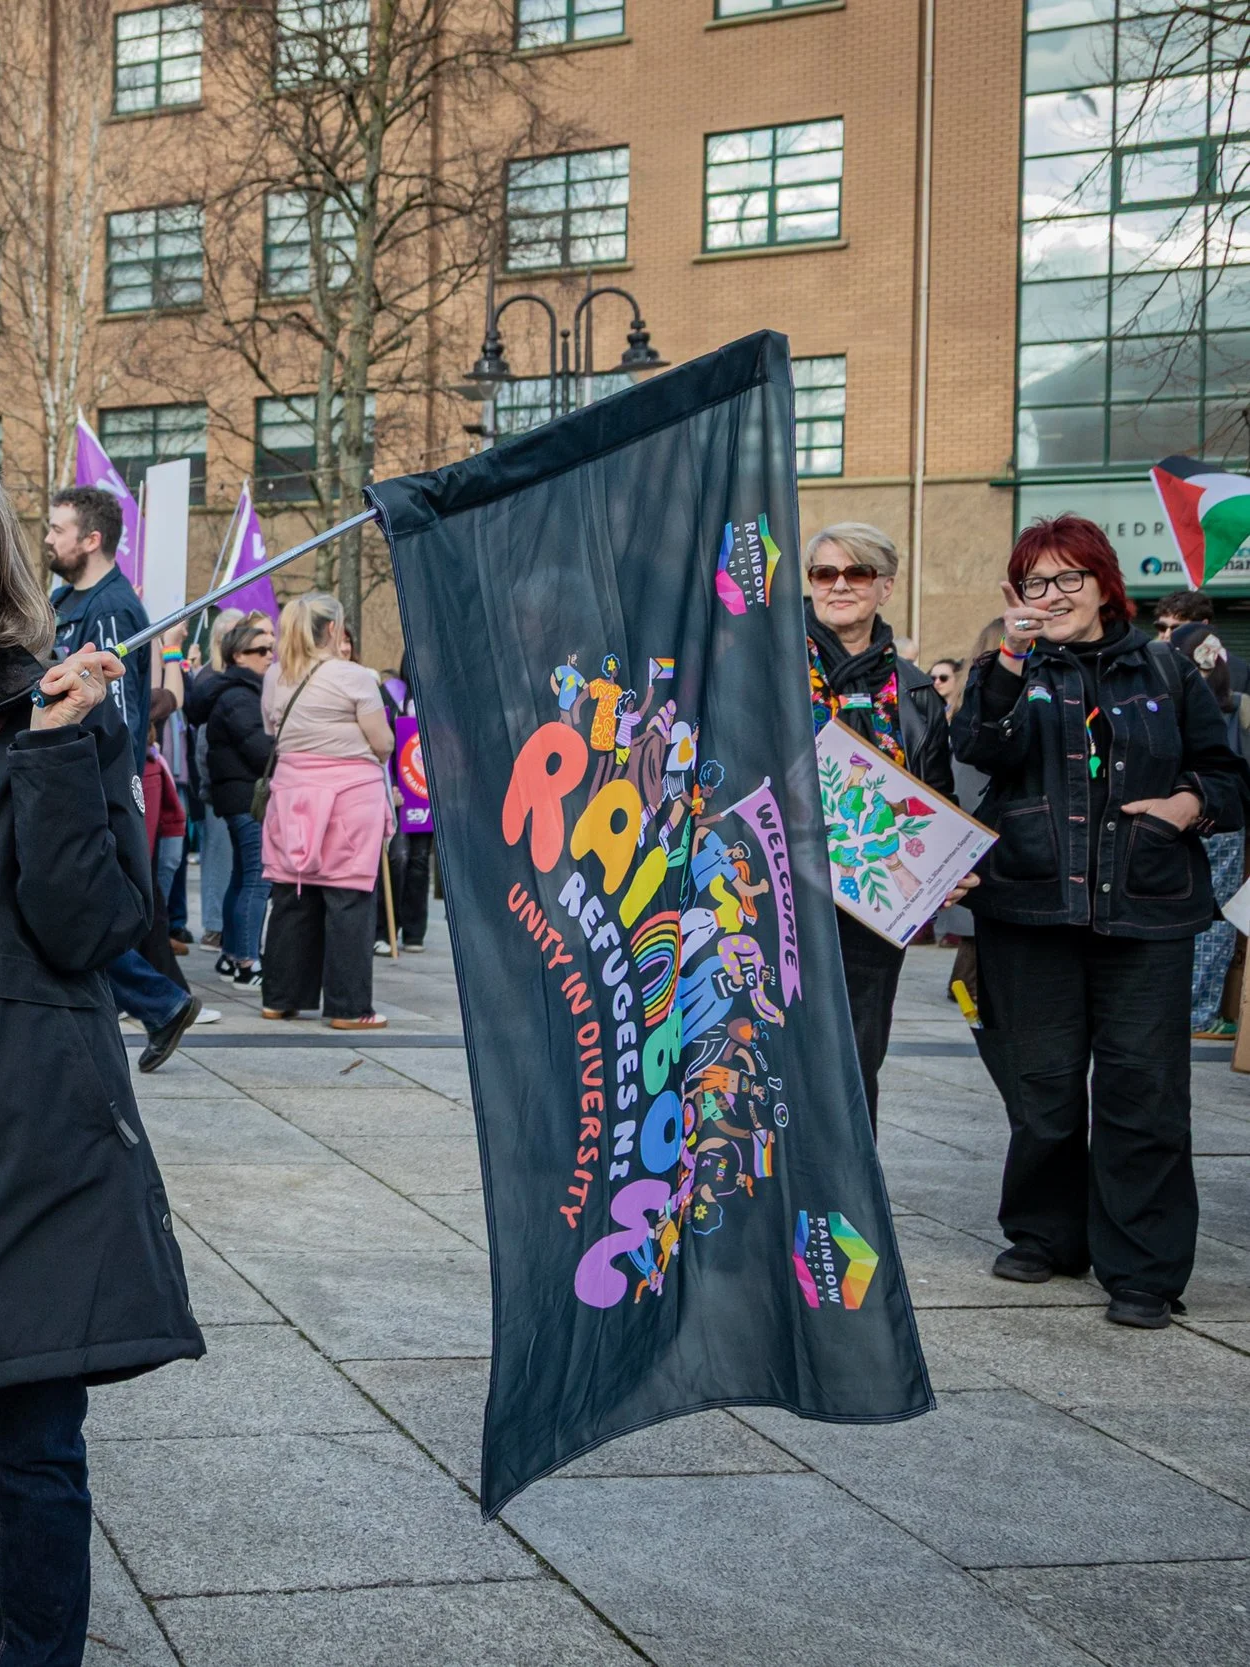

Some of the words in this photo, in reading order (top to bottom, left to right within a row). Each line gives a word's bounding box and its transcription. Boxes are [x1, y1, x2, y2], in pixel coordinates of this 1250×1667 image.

[729, 560, 737, 577] NI
[733, 526, 753, 606] REFUGEES
[744, 521, 765, 603] RAINBOW
[756, 803, 798, 972] WELCOME
[910, 888, 925, 903] March
[957, 830, 974, 848] Square
[508, 882, 573, 968] UNITY
[558, 872, 638, 1111] REFUGEES
[609, 1120, 636, 1181] NI
[561, 971, 592, 1015] IN
[560, 1021, 604, 1229] DIVERSITY
[808, 1218, 825, 1302] REFUGEES
[817, 1217, 841, 1304] RAINBOW
